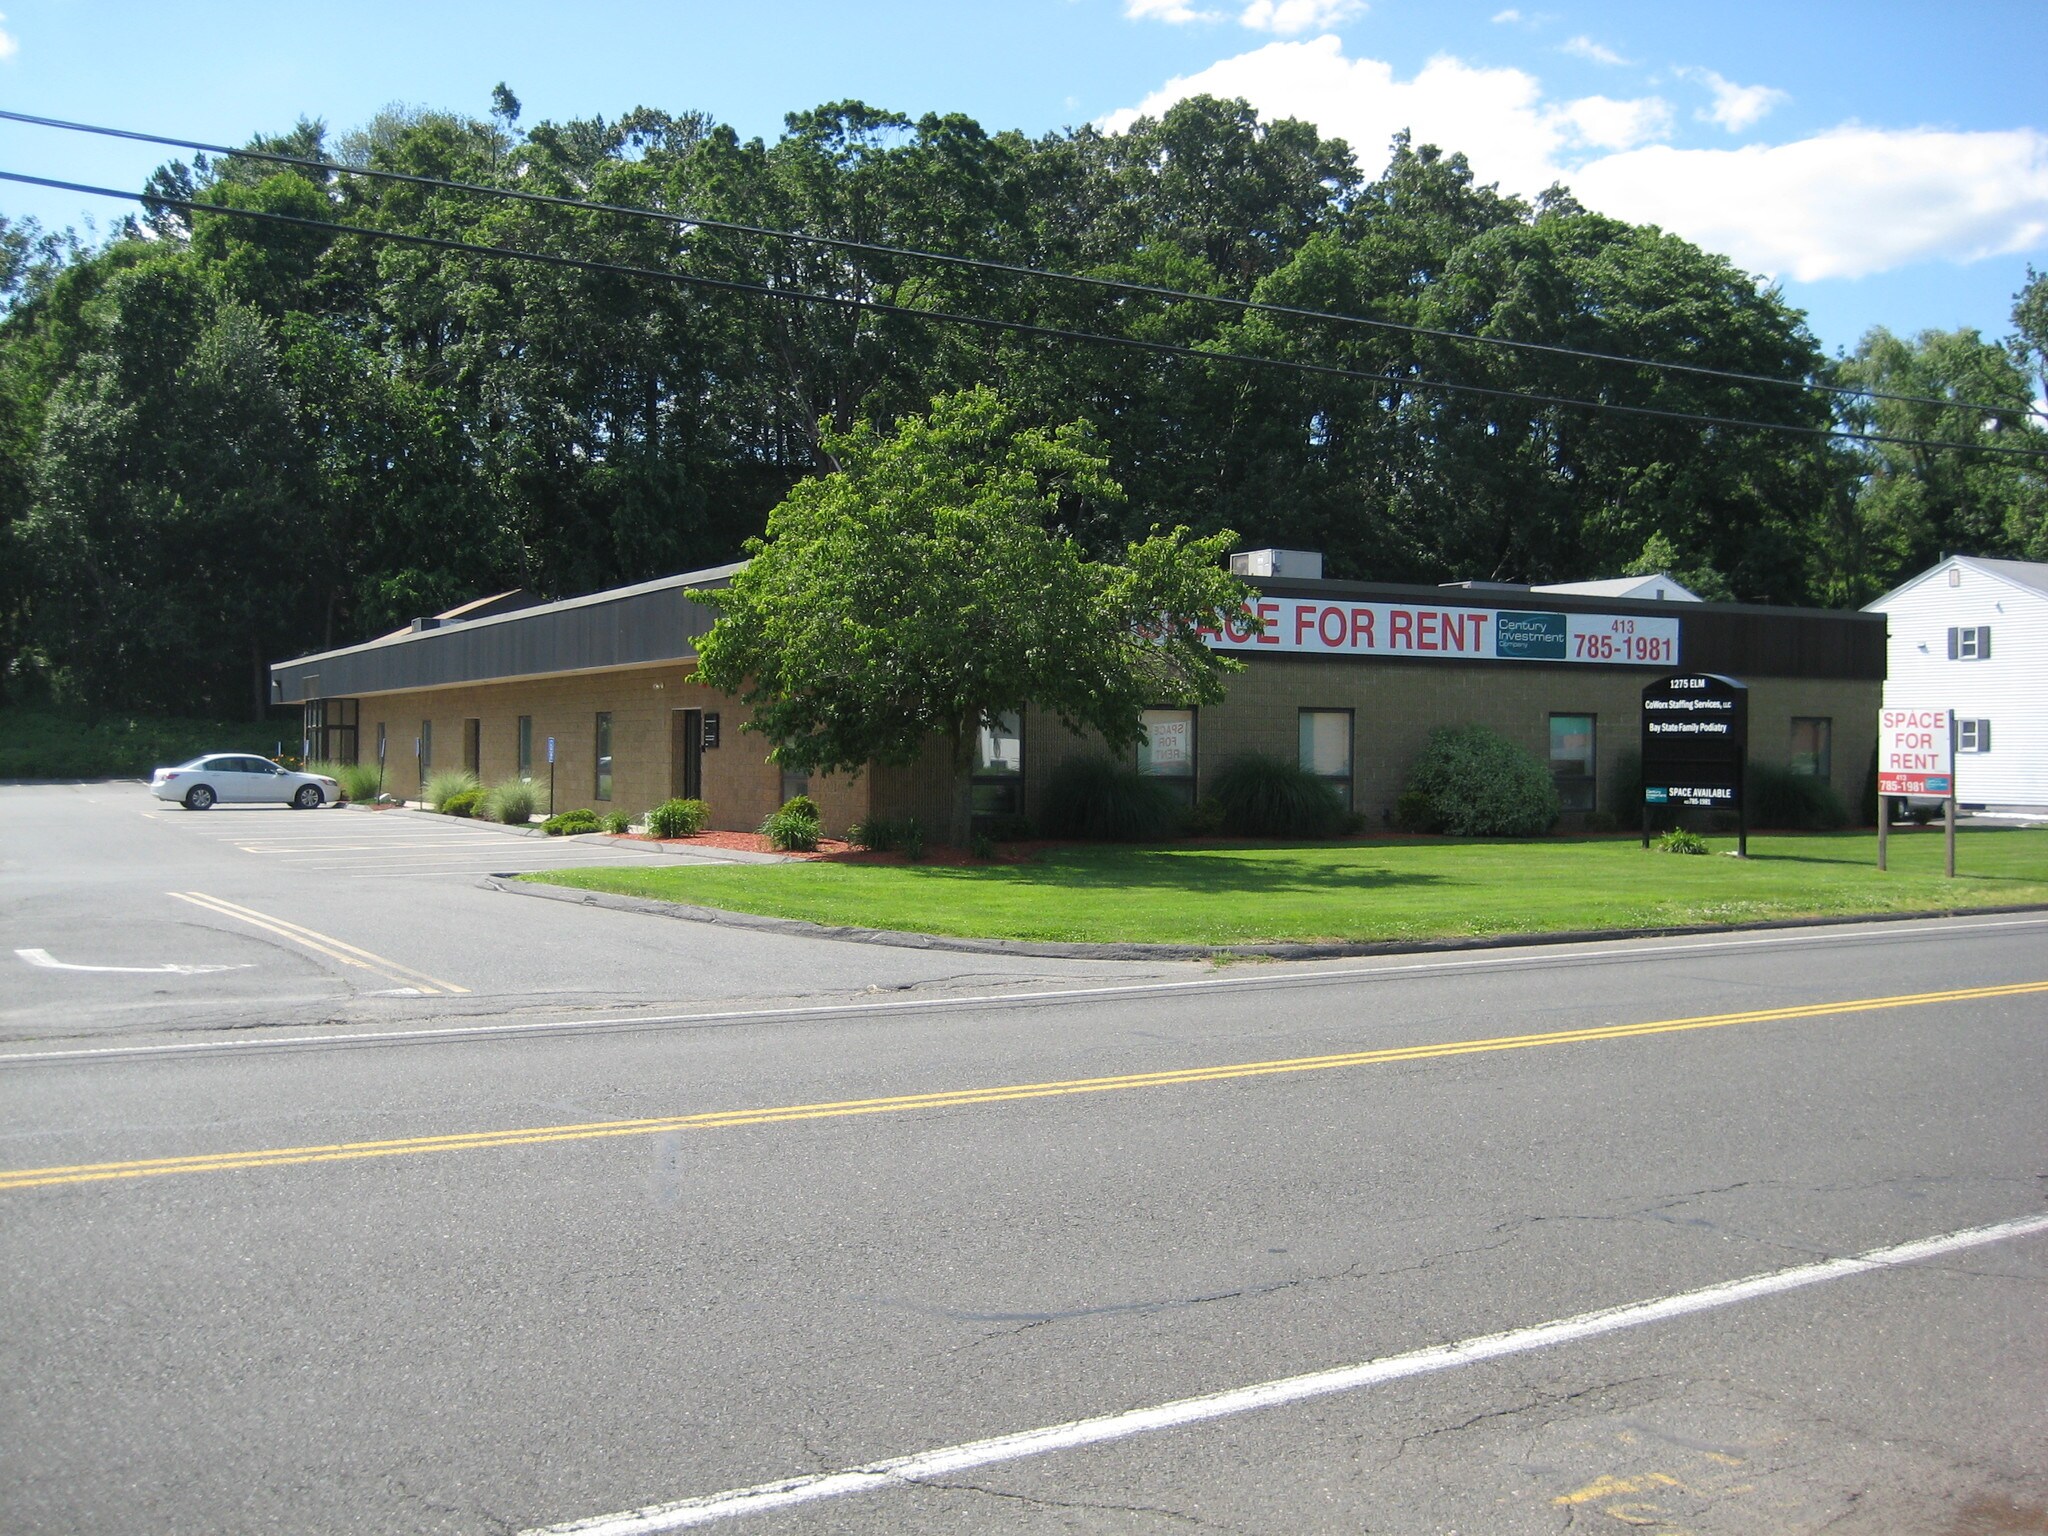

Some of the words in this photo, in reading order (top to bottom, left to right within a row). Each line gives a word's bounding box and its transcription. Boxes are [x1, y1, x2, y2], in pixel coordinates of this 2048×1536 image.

[1295, 605, 1375, 648] FOR
[1390, 610, 1488, 652] RENT
[1499, 619, 1547, 632] Century
[1611, 619, 1635, 634] 413
[1499, 631, 1565, 643] Investment
[1499, 640, 1529, 649] Company
[1573, 634, 1672, 661] 785-1981
[1670, 679, 1689, 689] 1275
[1690, 678, 1705, 689] ELM
[1669, 700, 1694, 710] Staffing
[1694, 700, 1722, 709] Services,
[1883, 712, 1945, 729] SPACE
[1649, 723, 1661, 733] Bay
[1661, 723, 1678, 732] State
[1678, 723, 1699, 733] Family
[1700, 723, 1727, 733] Podiatry
[1895, 733, 1932, 749] FOR
[1890, 753, 1939, 770] RENT
[1880, 780, 1925, 792] 785-1981
[1669, 787, 1692, 797] SPACE
[1693, 788, 1731, 798] AVAILABLE
